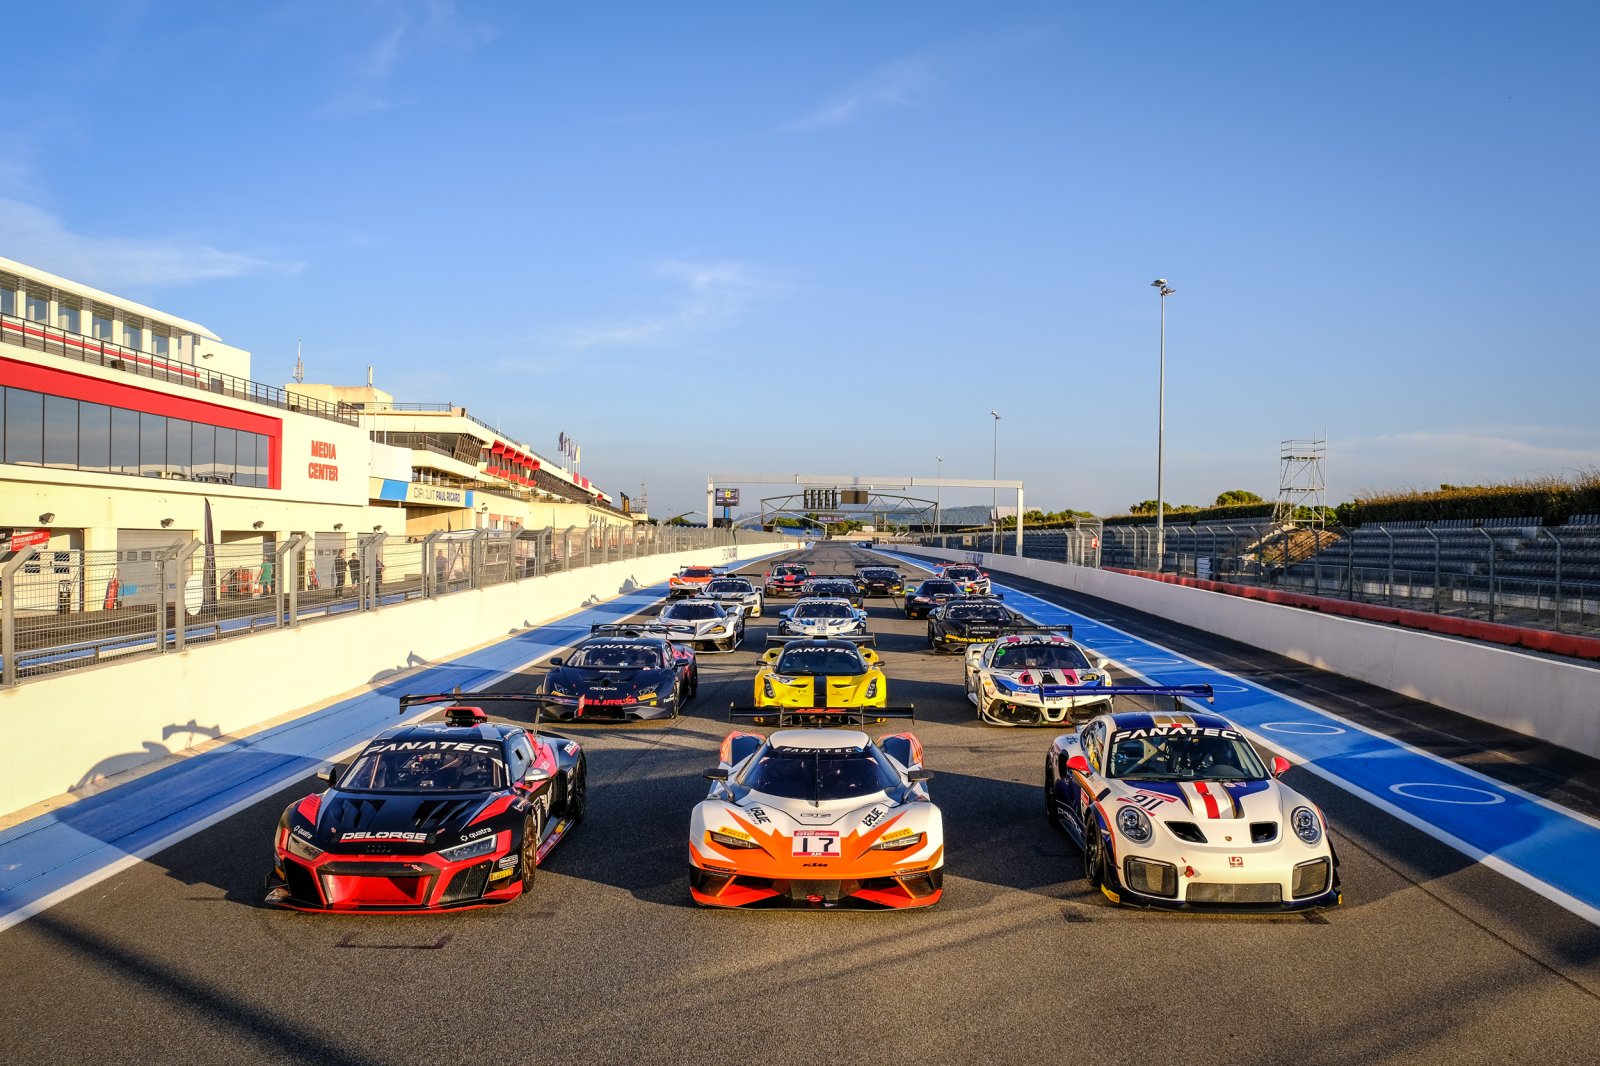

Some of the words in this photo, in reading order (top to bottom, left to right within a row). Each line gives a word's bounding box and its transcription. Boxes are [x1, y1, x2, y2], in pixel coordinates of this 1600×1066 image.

[311, 440, 336, 460] MEDIA
[308, 462, 338, 481] CENTER
[414, 487, 435, 500] CIRUIT
[436, 490, 446, 501] PAUL
[446, 491, 461, 503] RICARD
[785, 647, 854, 655] FANATEC
[1001, 640, 1071, 648] FANATEC
[1114, 727, 1238, 743] FANATEC
[363, 741, 494, 756] FANATEC
[1126, 794, 1164, 811] 911
[341, 831, 427, 841] DELORGE
[469, 827, 492, 838] quatra
[803, 837, 834, 852] 17
